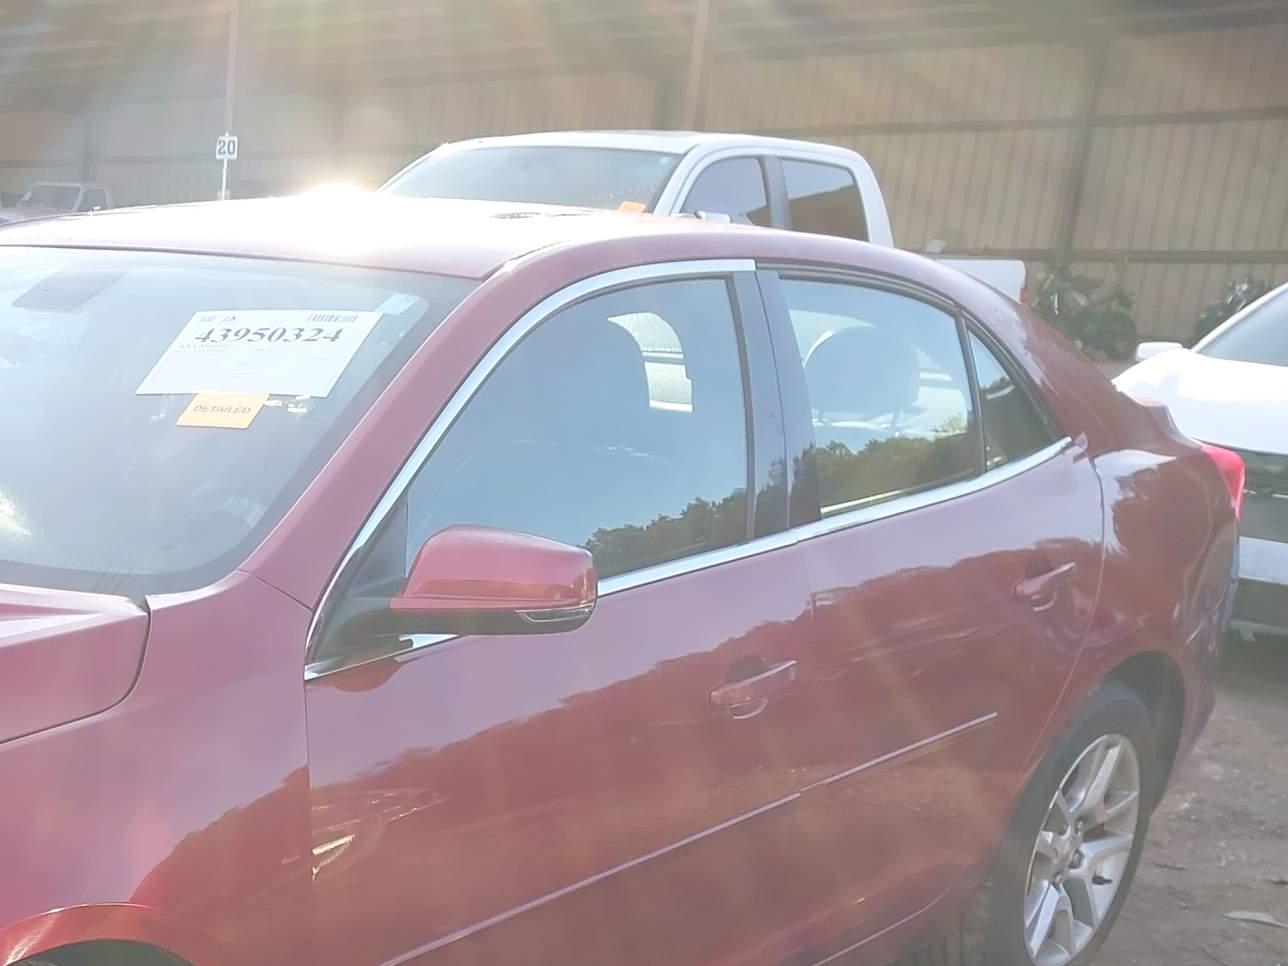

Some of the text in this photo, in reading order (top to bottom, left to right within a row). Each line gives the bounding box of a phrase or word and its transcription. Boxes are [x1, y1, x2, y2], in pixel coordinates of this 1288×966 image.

[217, 139, 235, 155] 20
[194, 327, 345, 343] 43950324
[193, 404, 252, 414] DETAILED
